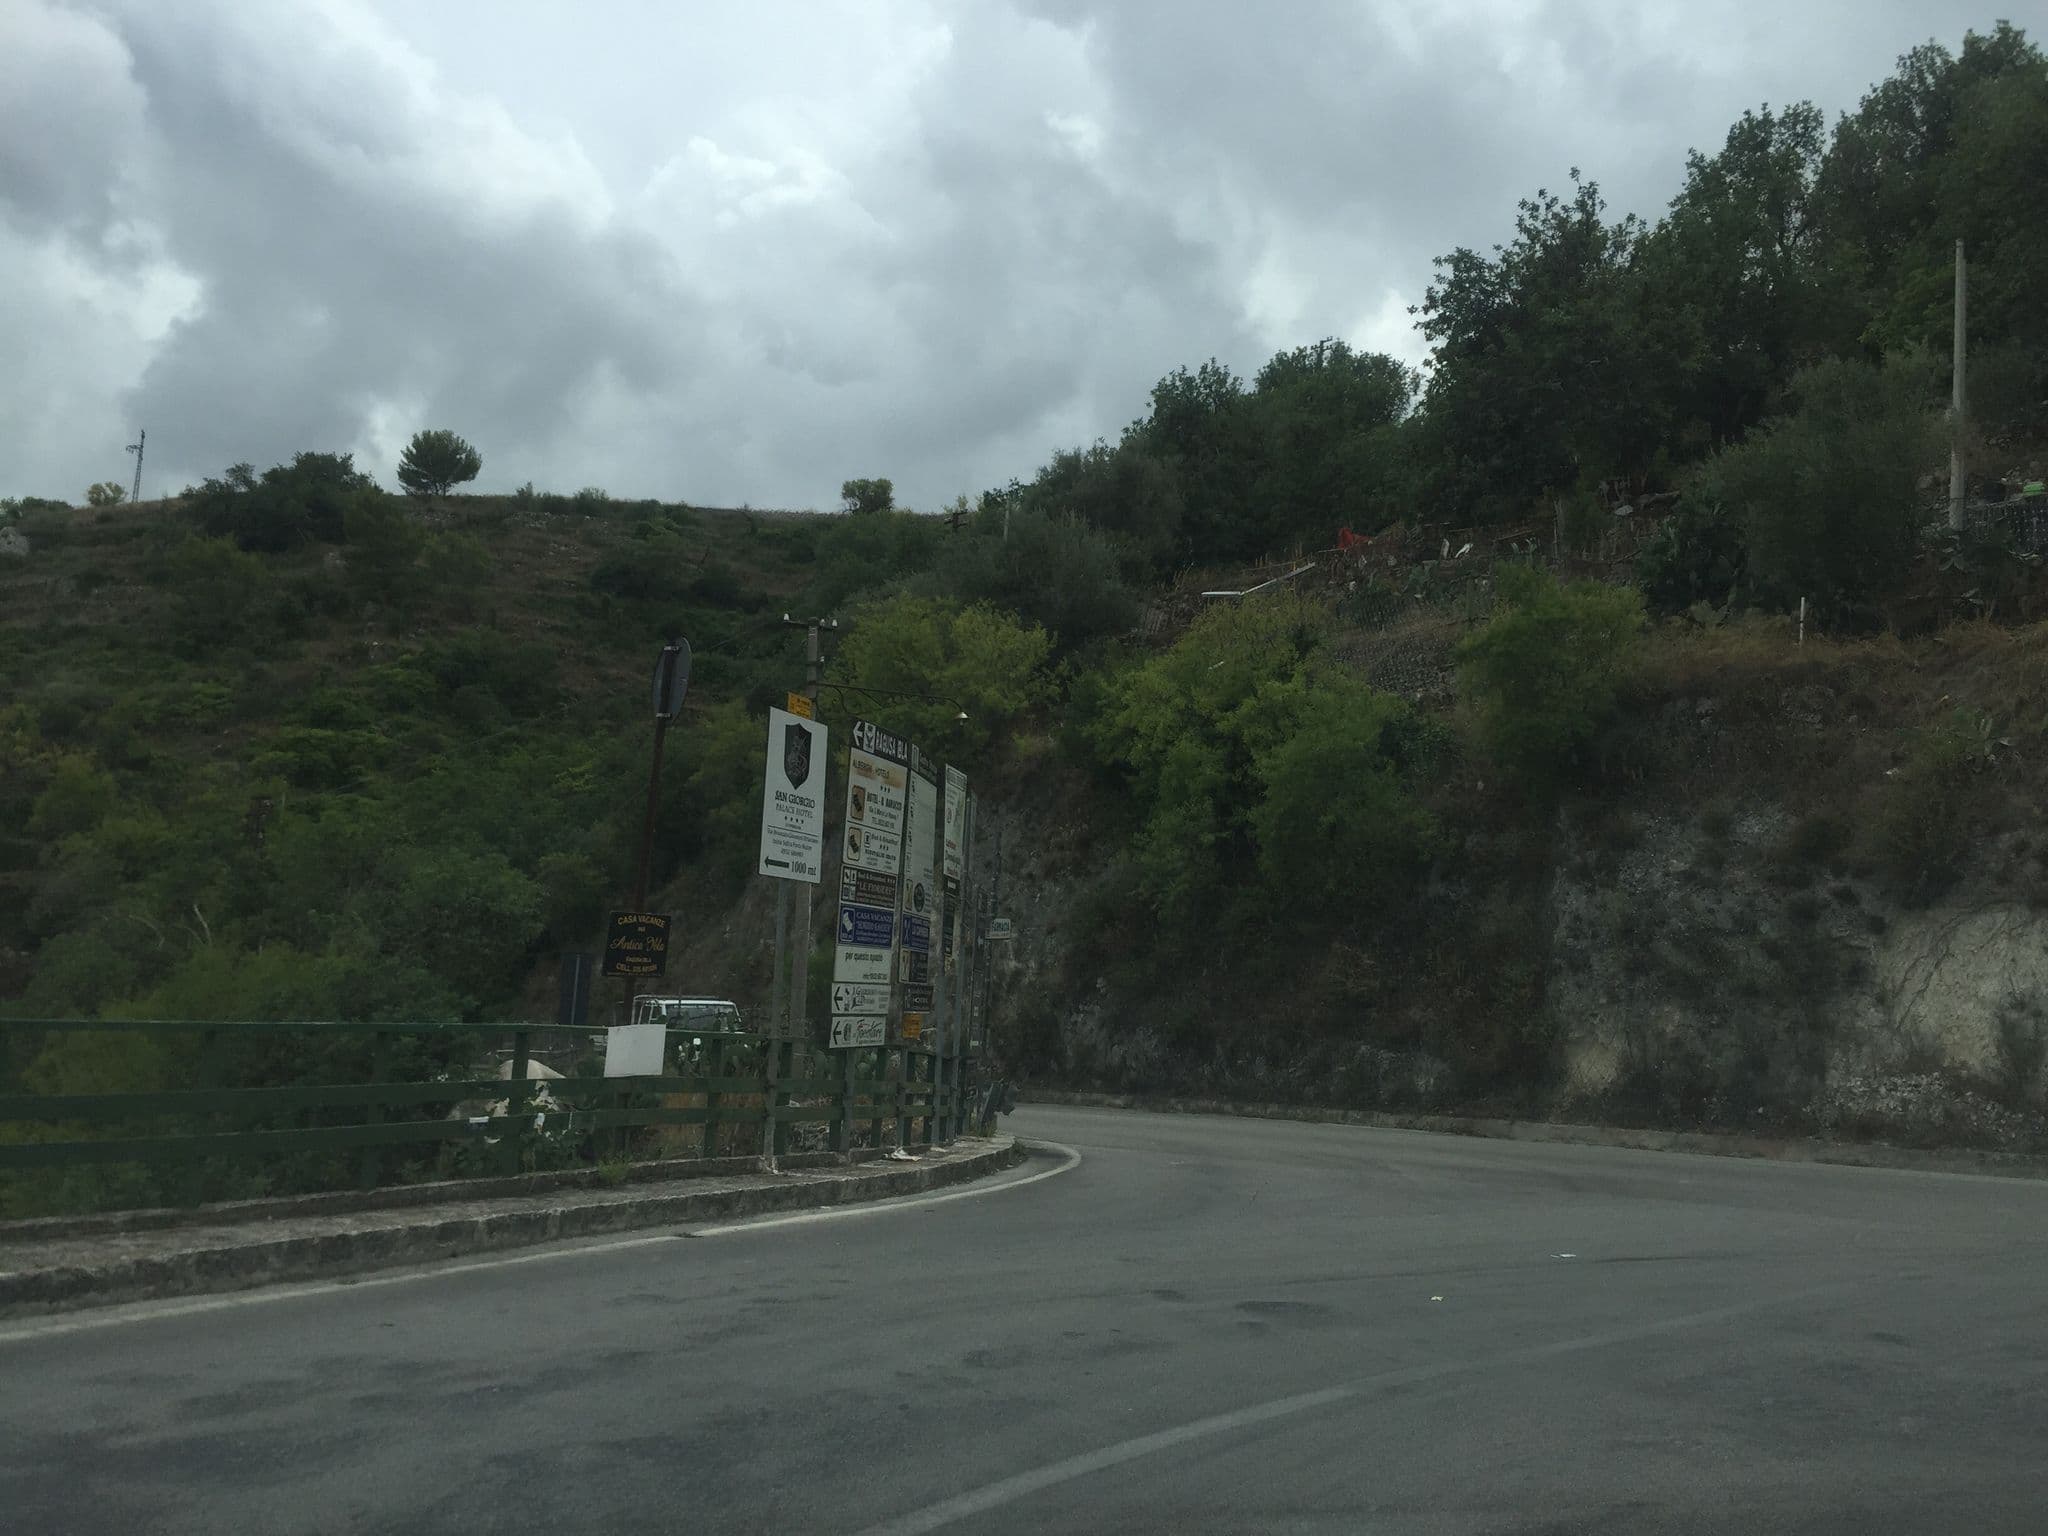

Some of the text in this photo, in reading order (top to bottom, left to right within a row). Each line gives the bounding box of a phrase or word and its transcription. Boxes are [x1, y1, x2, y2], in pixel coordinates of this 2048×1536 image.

[876, 730, 908, 760] RAGUSA IBLA
[775, 790, 816, 808] SAN GIORGIO
[776, 803, 814, 818] PALACE HOTEL
[791, 860, 817, 876] 1000 mt
[618, 914, 665, 928] CASA VACANZE
[845, 952, 854, 962] per
